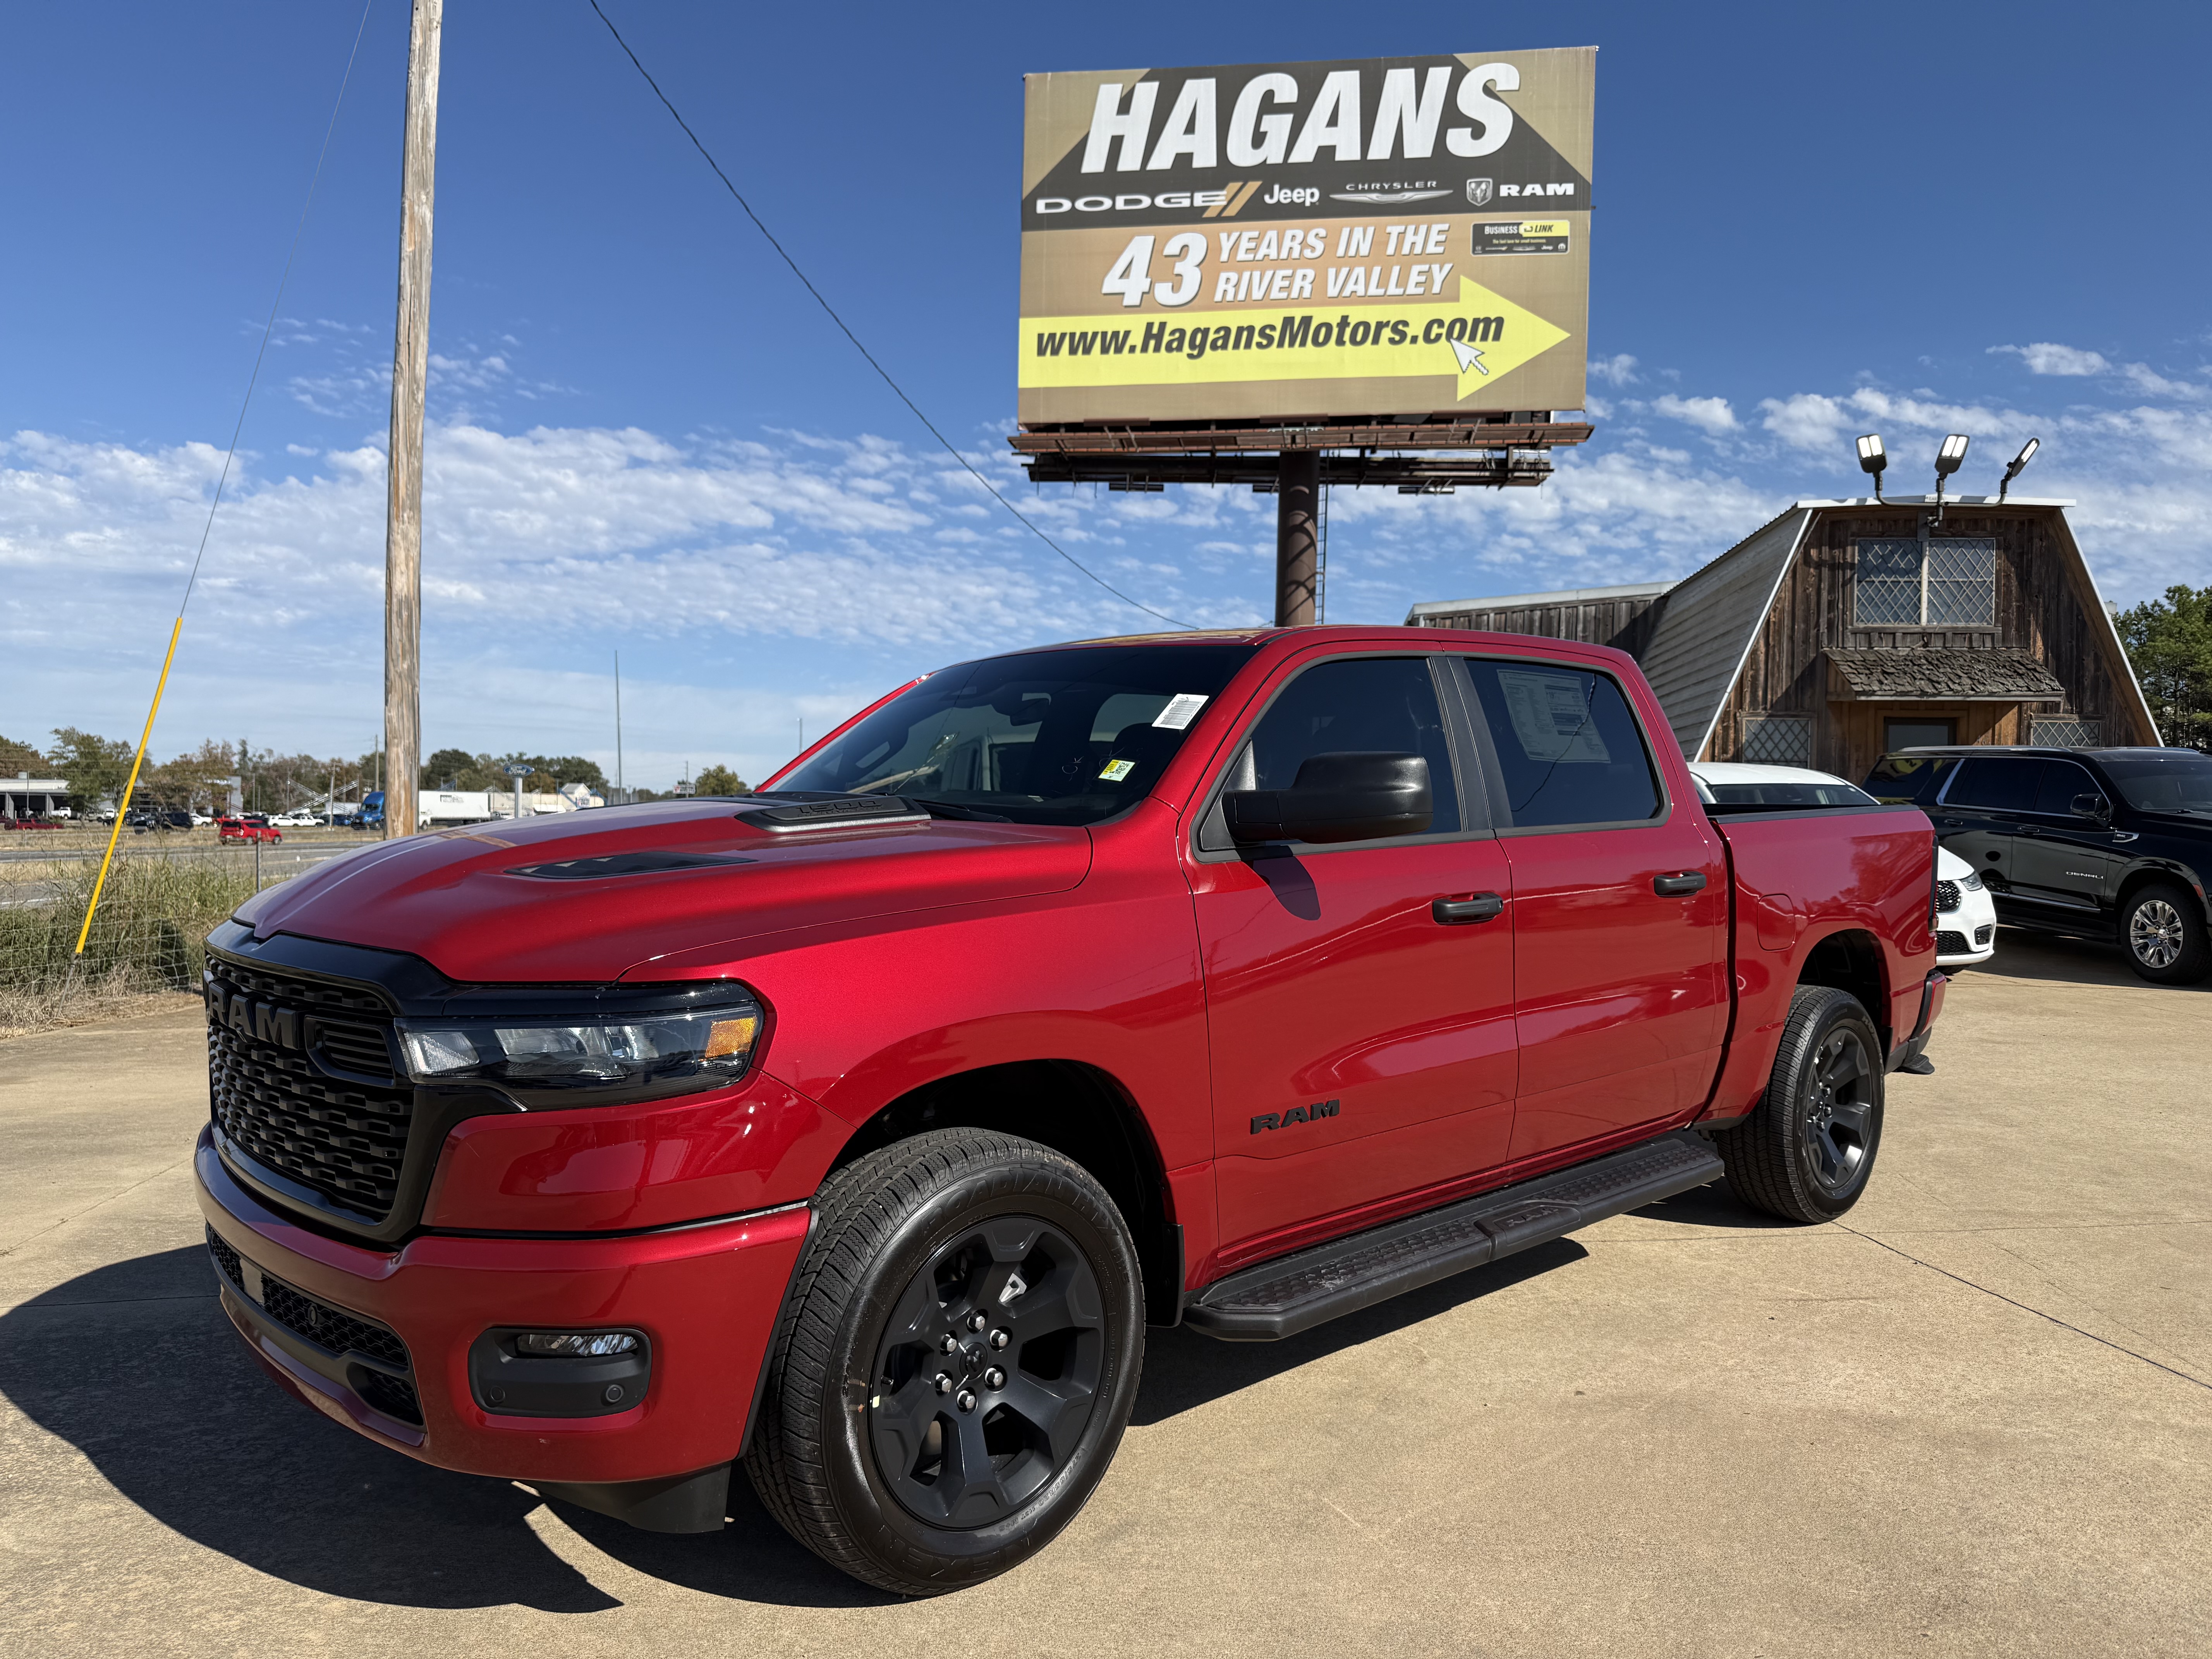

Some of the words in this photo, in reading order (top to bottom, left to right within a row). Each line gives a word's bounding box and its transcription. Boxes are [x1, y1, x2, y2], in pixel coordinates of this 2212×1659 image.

[1081, 63, 1520, 173] HAGANS
[1036, 191, 1228, 214] DODGE
[1264, 184, 1320, 206] Jeep
[1346, 180, 1437, 191] CHRYSLER
[1499, 182, 1575, 197] RAM
[1218, 230, 1325, 263] YEARS
[1336, 228, 1376, 257] IN
[1385, 223, 1450, 254] THE
[1485, 226, 1518, 234] BUSINESS
[1102, 233, 1207, 307] 43
[1213, 269, 1315, 302] RIVER
[1327, 263, 1453, 297] VALLEY
[1036, 314, 1504, 360] www.HagansMotors.com
[796, 801, 882, 814] 1500
[2066, 871, 2104, 879] DENALI
[208, 982, 299, 1050] RAM
[1250, 1099, 1340, 1135] RAM
[921, 1170, 1065, 1237] ROADIAN
